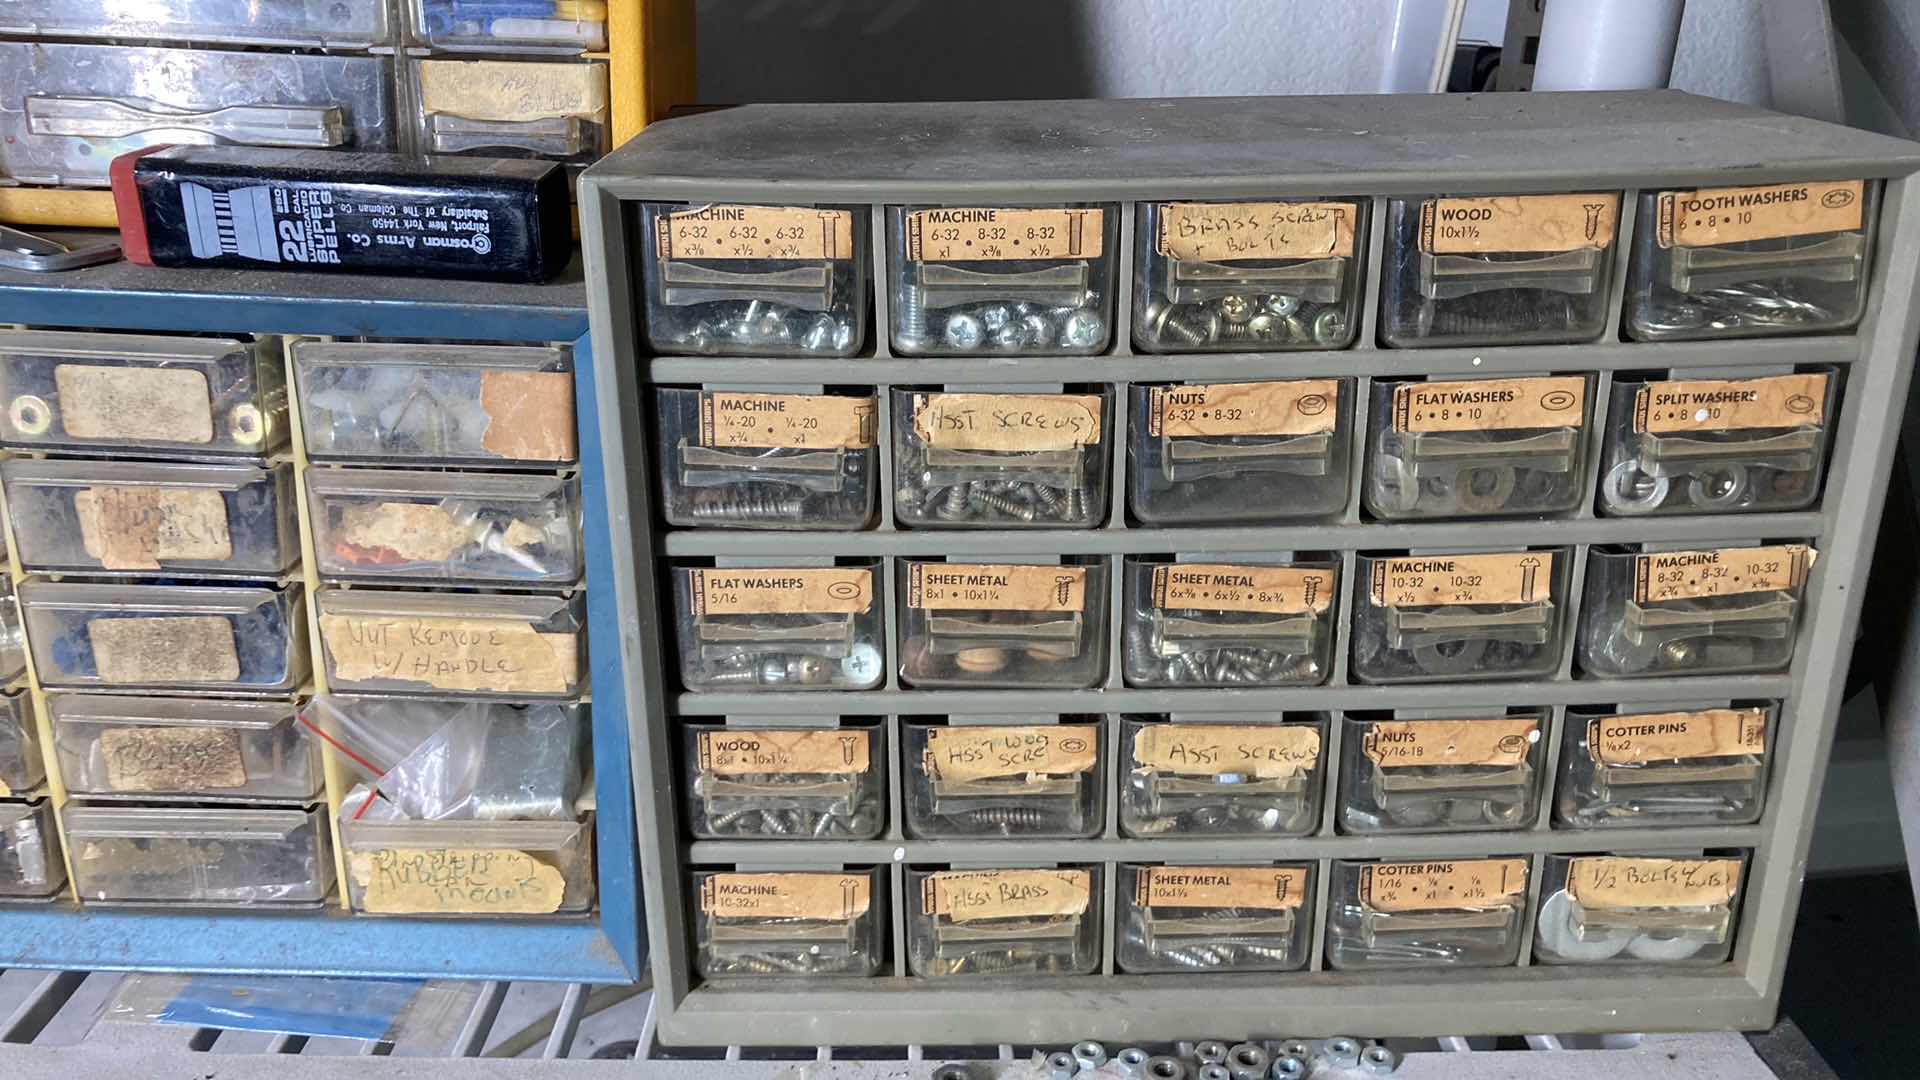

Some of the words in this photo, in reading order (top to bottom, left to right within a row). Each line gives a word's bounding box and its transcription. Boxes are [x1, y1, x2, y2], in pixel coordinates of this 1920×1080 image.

[1681, 196, 1734, 213] TOOTH
[1739, 188, 1808, 206] WASHERS
[359, 204, 395, 216] Coleman
[403, 206, 418, 216] The
[425, 206, 435, 216] of
[442, 206, 489, 220] Subsidiary
[1441, 208, 1492, 221] WOOD
[372, 218, 399, 229] 14450
[928, 210, 996, 224] MACHINE
[1679, 218, 1687, 230] 6
[1708, 215, 1716, 227] 8
[1738, 212, 1751, 225] 10
[308, 191, 328, 263] SUPER
[321, 191, 341, 264] PELLS
[403, 219, 425, 231] York
[428, 220, 448, 231] New
[451, 221, 490, 234] Fairport,
[680, 226, 708, 239] 6-32
[729, 226, 758, 239] 6-32
[776, 227, 805, 239] 6-32
[931, 229, 960, 241] 6-32
[978, 228, 1007, 240] 8-32
[1027, 227, 1055, 240] 8-32
[279, 220, 309, 263] 22
[347, 233, 370, 247] Co.
[377, 234, 416, 249] Arms
[422, 233, 491, 254] Crosman
[1169, 393, 1205, 405] NUTS
[1416, 392, 1448, 405] FLAT
[1450, 391, 1514, 404] WASHERS
[1656, 393, 1689, 405] SPLIT
[1692, 391, 1757, 403] WASHERS
[720, 399, 785, 412] MACHINE
[1168, 409, 1195, 421] 6-32
[1214, 408, 1242, 421] 8-32
[1415, 409, 1422, 421] 6
[1441, 408, 1449, 421] 8
[1468, 408, 1482, 420] 10
[1653, 410, 1661, 421] 6
[1680, 409, 1688, 421] 8
[1656, 552, 1720, 568] MACHINE
[1391, 561, 1454, 573] MACHINE
[1657, 570, 1684, 583] 8-32
[1702, 567, 1729, 579] 8-32
[1746, 562, 1779, 575] 10-32
[711, 578, 740, 589] FLAT
[743, 578, 804, 589] WASHERS
[926, 574, 965, 585] SHEET
[967, 575, 1008, 586] METAL
[1172, 573, 1211, 585] SHEET
[1213, 574, 1254, 587] METAL
[1391, 576, 1424, 588] 10-32
[1450, 575, 1482, 587] 10-32
[711, 592, 737, 604] 5/16
[926, 588, 944, 600] 8x1
[413, 655, 524, 675] HANDLE
[1606, 725, 1654, 737] COTTER
[1658, 722, 1687, 733] PINS
[1382, 733, 1416, 743] NUTS
[716, 741, 760, 751] WOOD
[1377, 864, 1424, 876] COTTER
[1426, 864, 1453, 874] PINS
[1154, 875, 1190, 885] SHEET
[1192, 875, 1231, 886] METAL
[1378, 878, 1402, 888] 1/16
[719, 884, 778, 896] MACHINE
[999, 884, 1049, 901] BRASS
